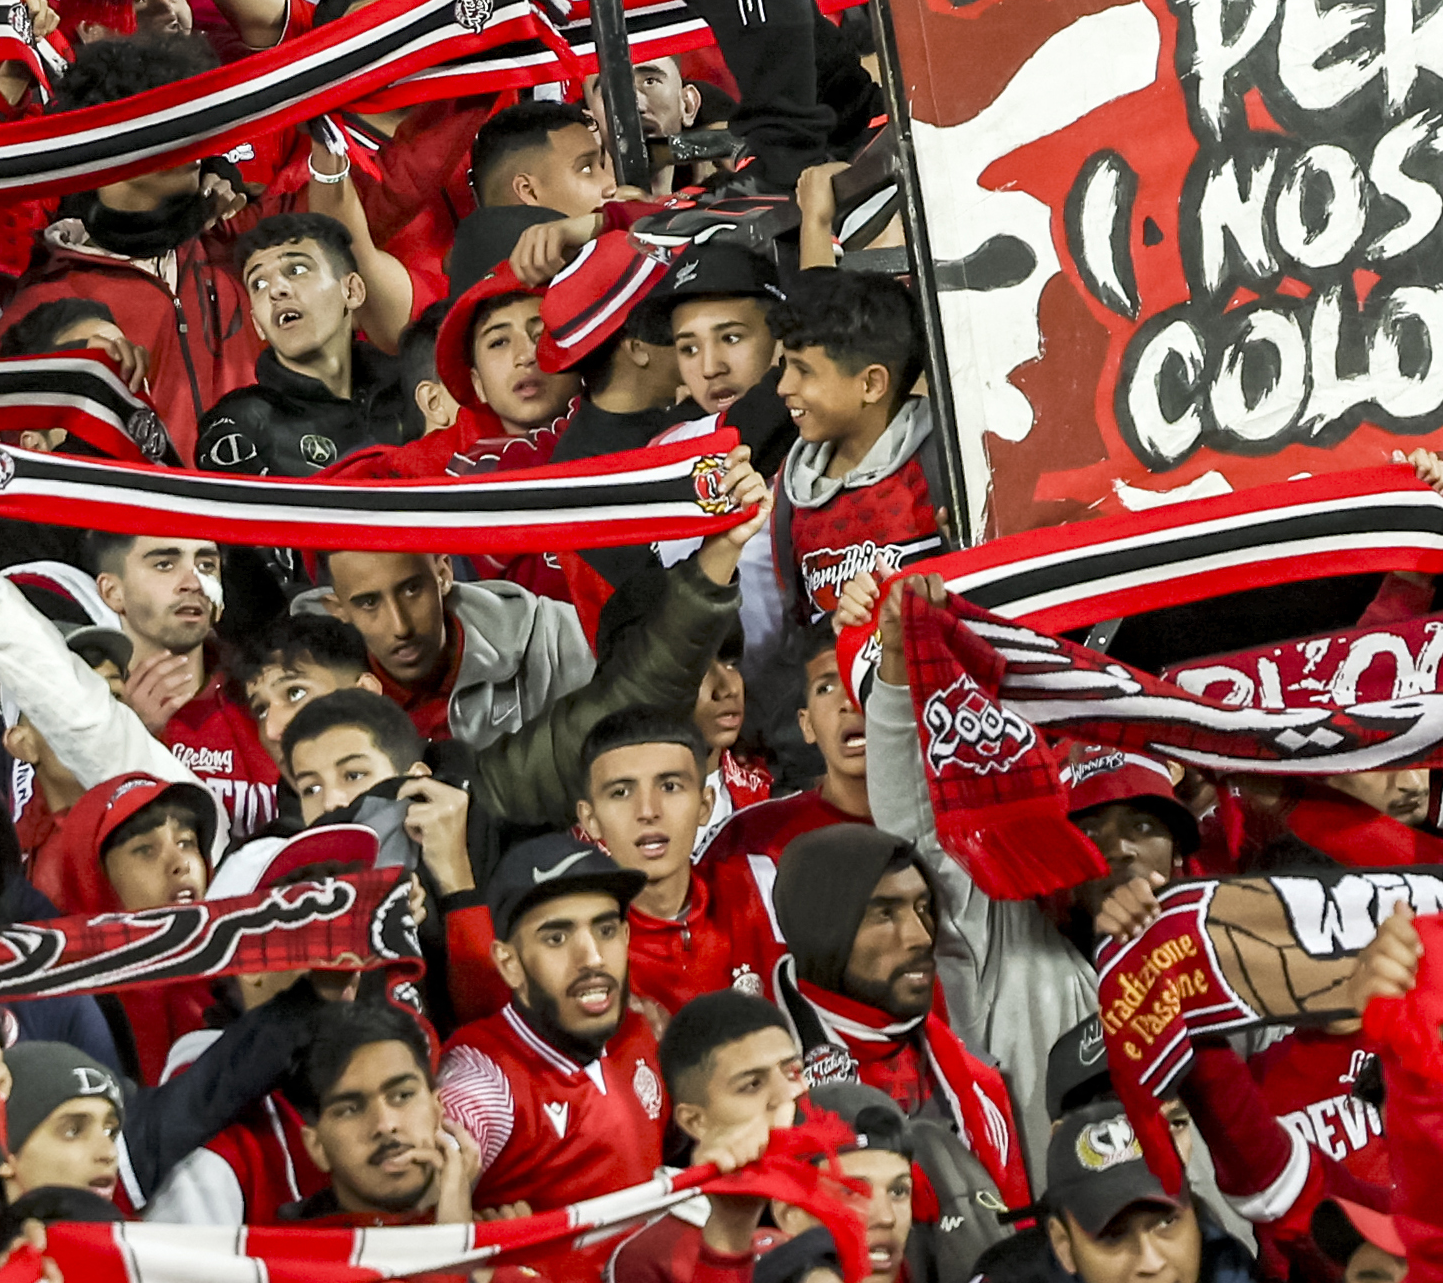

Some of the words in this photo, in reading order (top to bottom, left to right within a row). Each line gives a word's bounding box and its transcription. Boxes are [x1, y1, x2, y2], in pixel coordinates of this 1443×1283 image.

[1077, 157, 1138, 319] I
[172, 742, 233, 775] Lifelong
[1068, 750, 1126, 791] WINNERS
[1122, 1038, 1145, 1061] e
